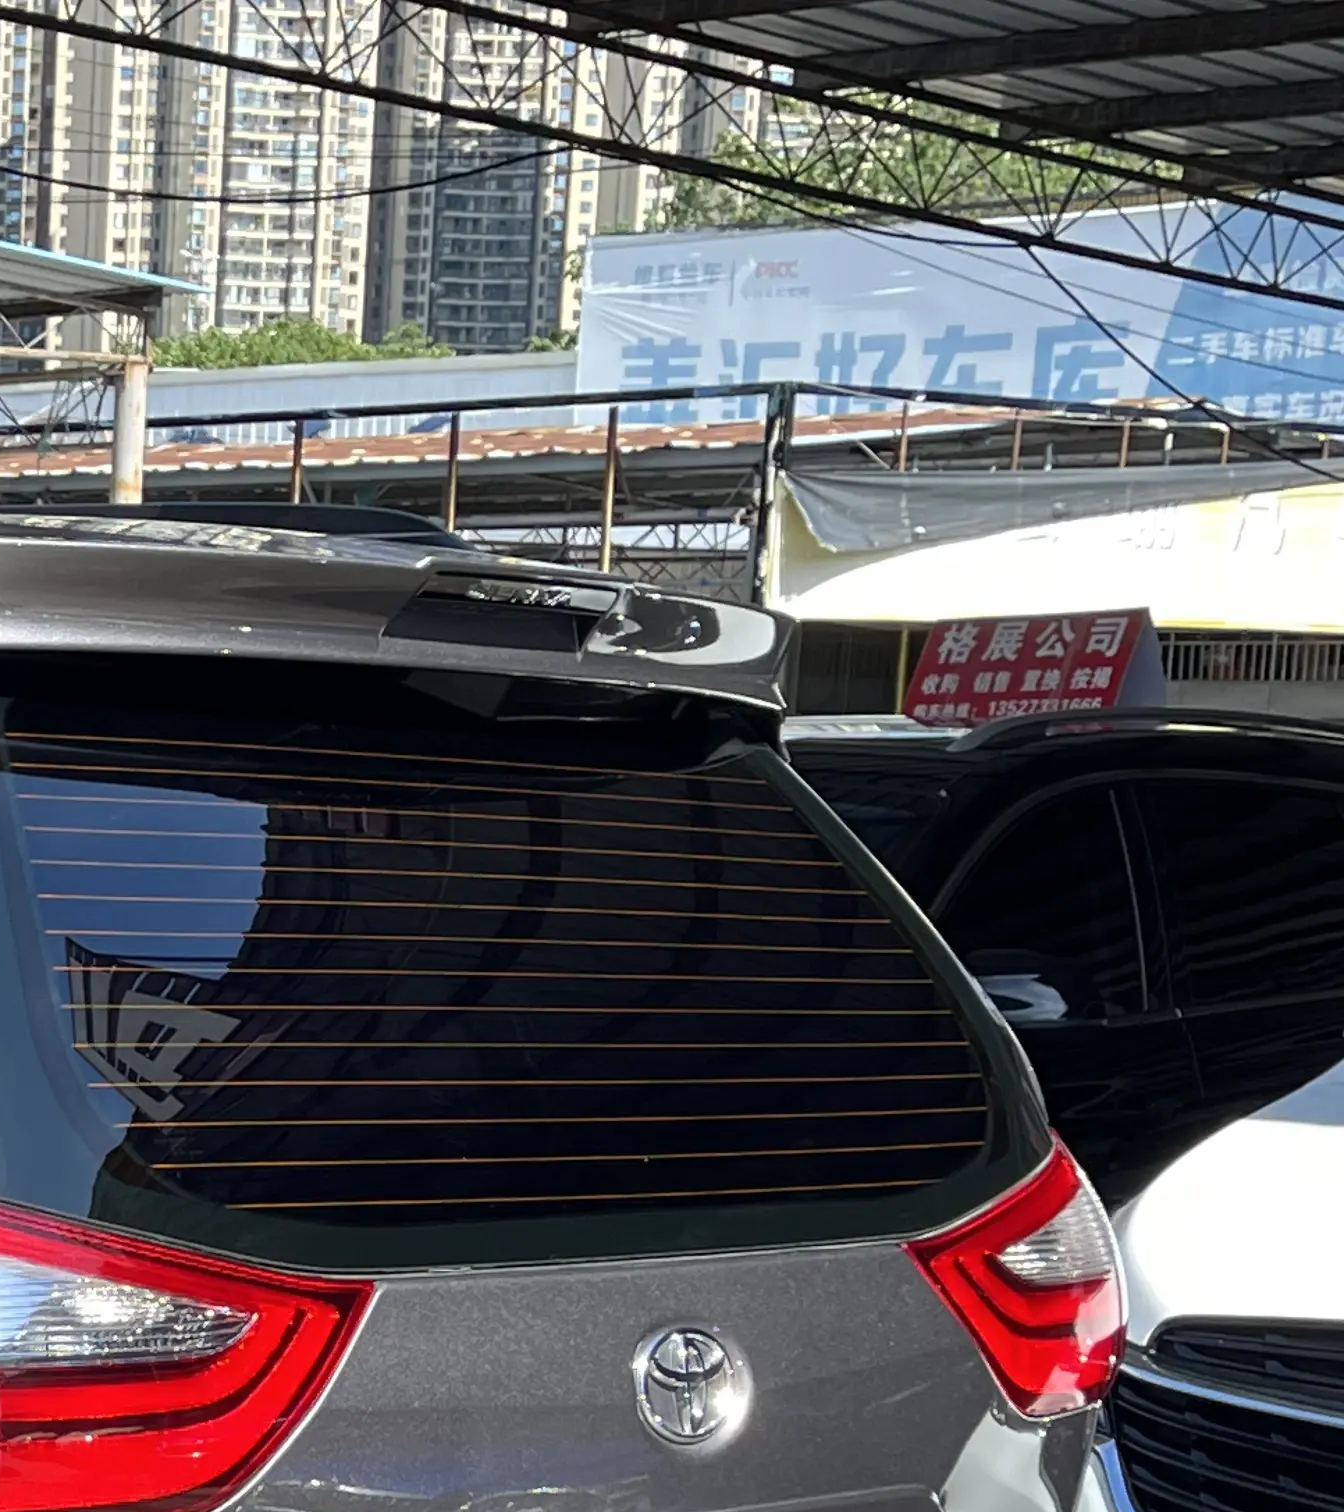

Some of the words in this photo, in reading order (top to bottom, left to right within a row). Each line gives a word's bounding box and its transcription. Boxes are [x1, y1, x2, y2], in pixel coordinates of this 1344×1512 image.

[936, 616, 1129, 665] 格展公司
[920, 673, 960, 695] 收购
